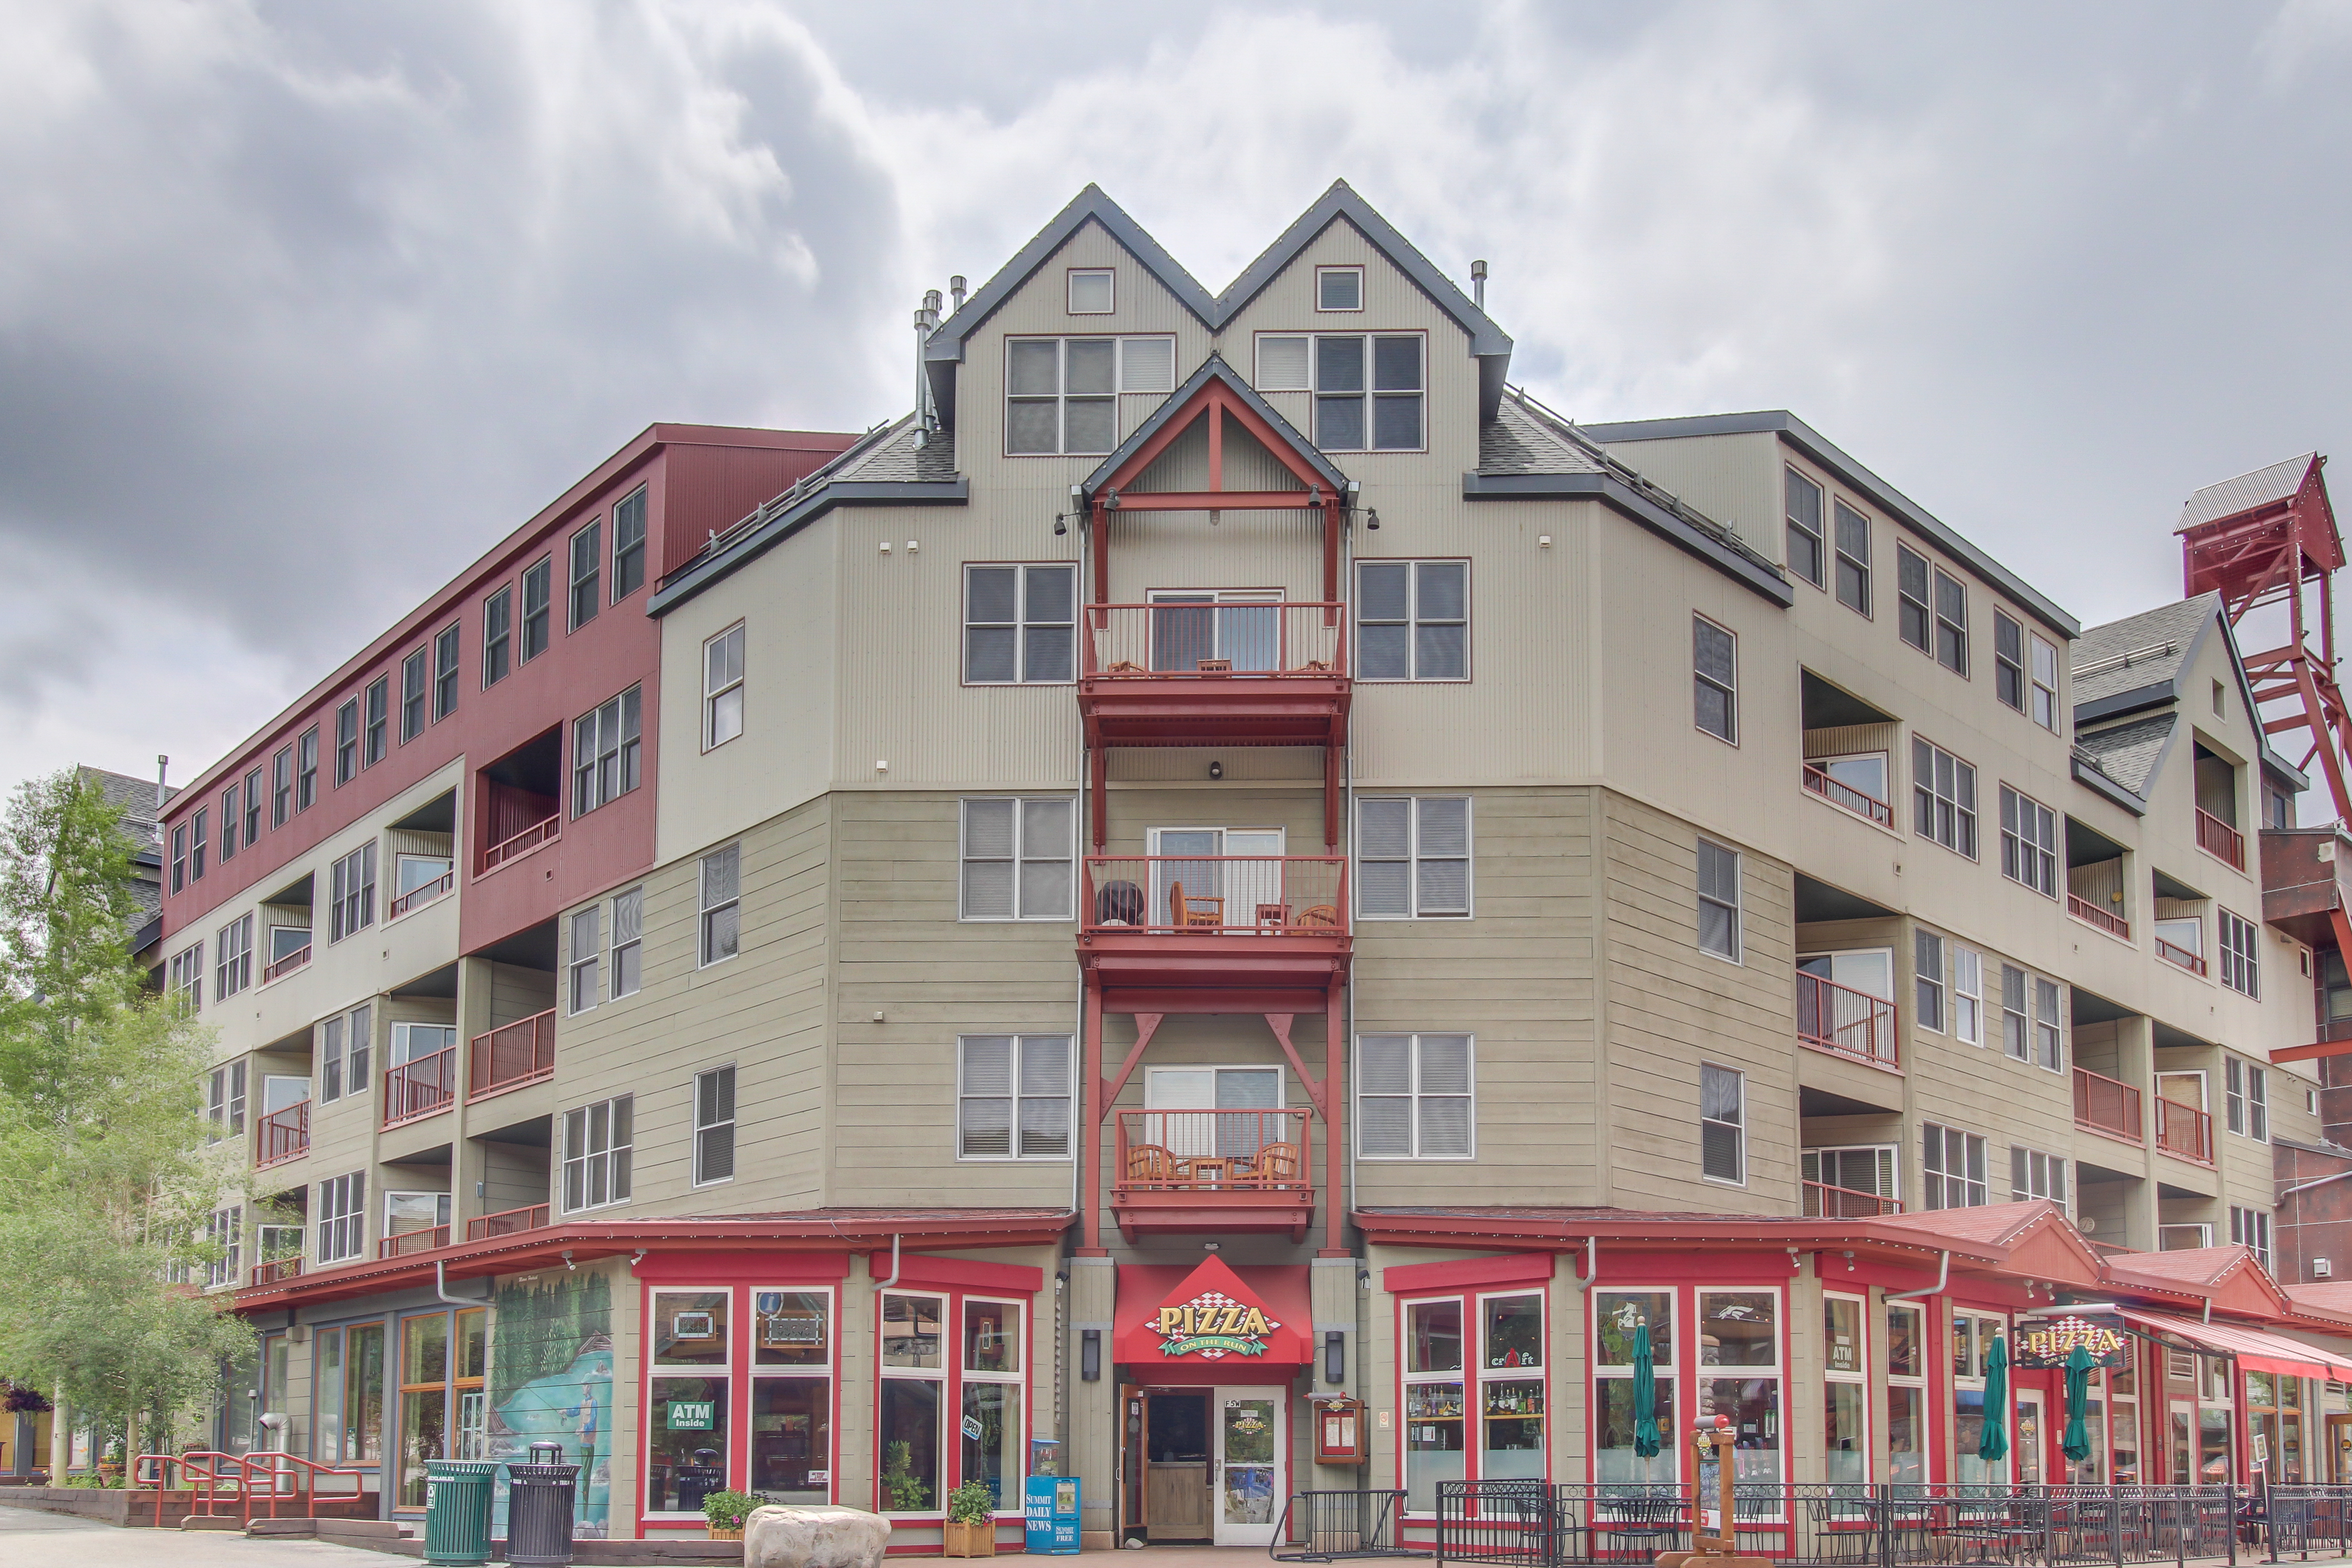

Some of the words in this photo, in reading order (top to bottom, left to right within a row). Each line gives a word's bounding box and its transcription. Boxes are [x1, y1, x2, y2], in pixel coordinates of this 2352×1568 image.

[1159, 1307, 1271, 1335] PIZZA
[1180, 1341, 1197, 1351] ON
[1223, 1340, 1247, 1351] RUN
[2028, 1329, 2120, 1353] PIZZA
[1833, 1345, 1851, 1361] ATM
[2043, 1356, 2059, 1365] ON
[672, 1404, 710, 1418] ATM
[964, 1418, 981, 1435] OPEN
[1026, 1494, 1052, 1504] SUMMIT
[1026, 1506, 1051, 1517] DAILY
[1026, 1520, 1051, 1531] NEWS
